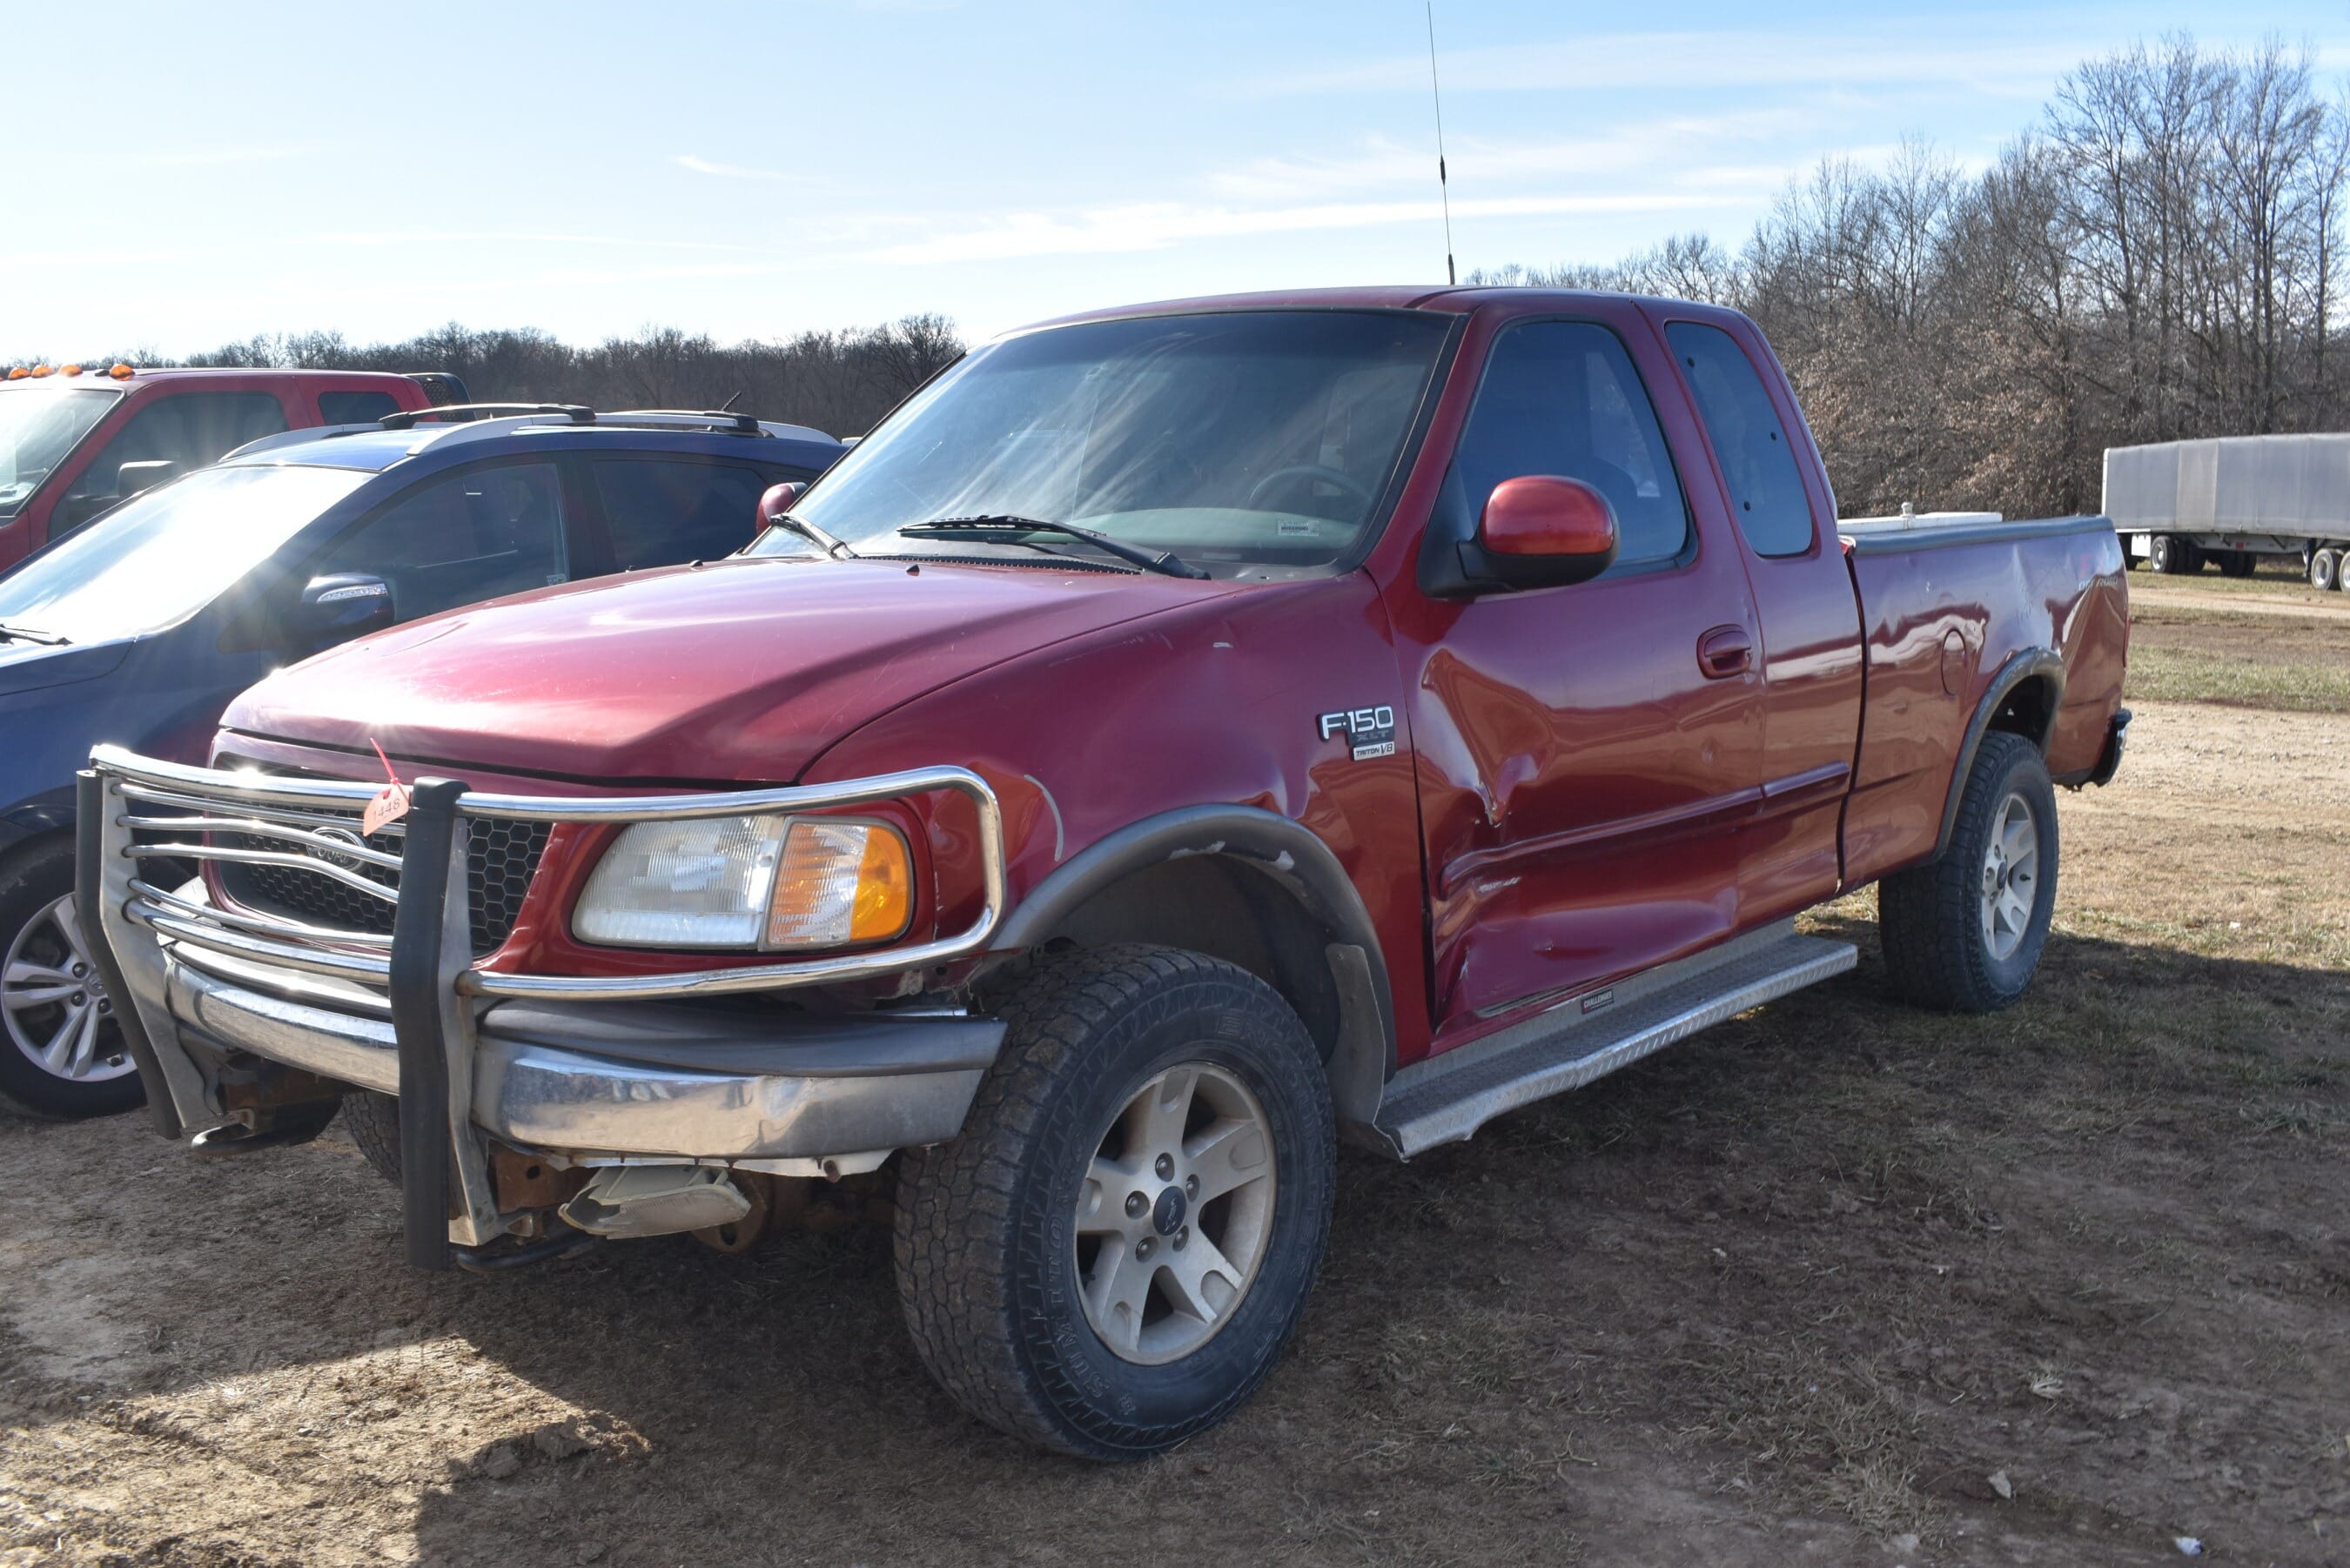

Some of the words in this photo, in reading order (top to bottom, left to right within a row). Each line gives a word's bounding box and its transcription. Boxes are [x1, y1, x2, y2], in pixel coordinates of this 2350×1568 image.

[1357, 729, 1388, 741] XLT
[1355, 747, 1380, 757] TRITON
[1380, 743, 1393, 754] V8
